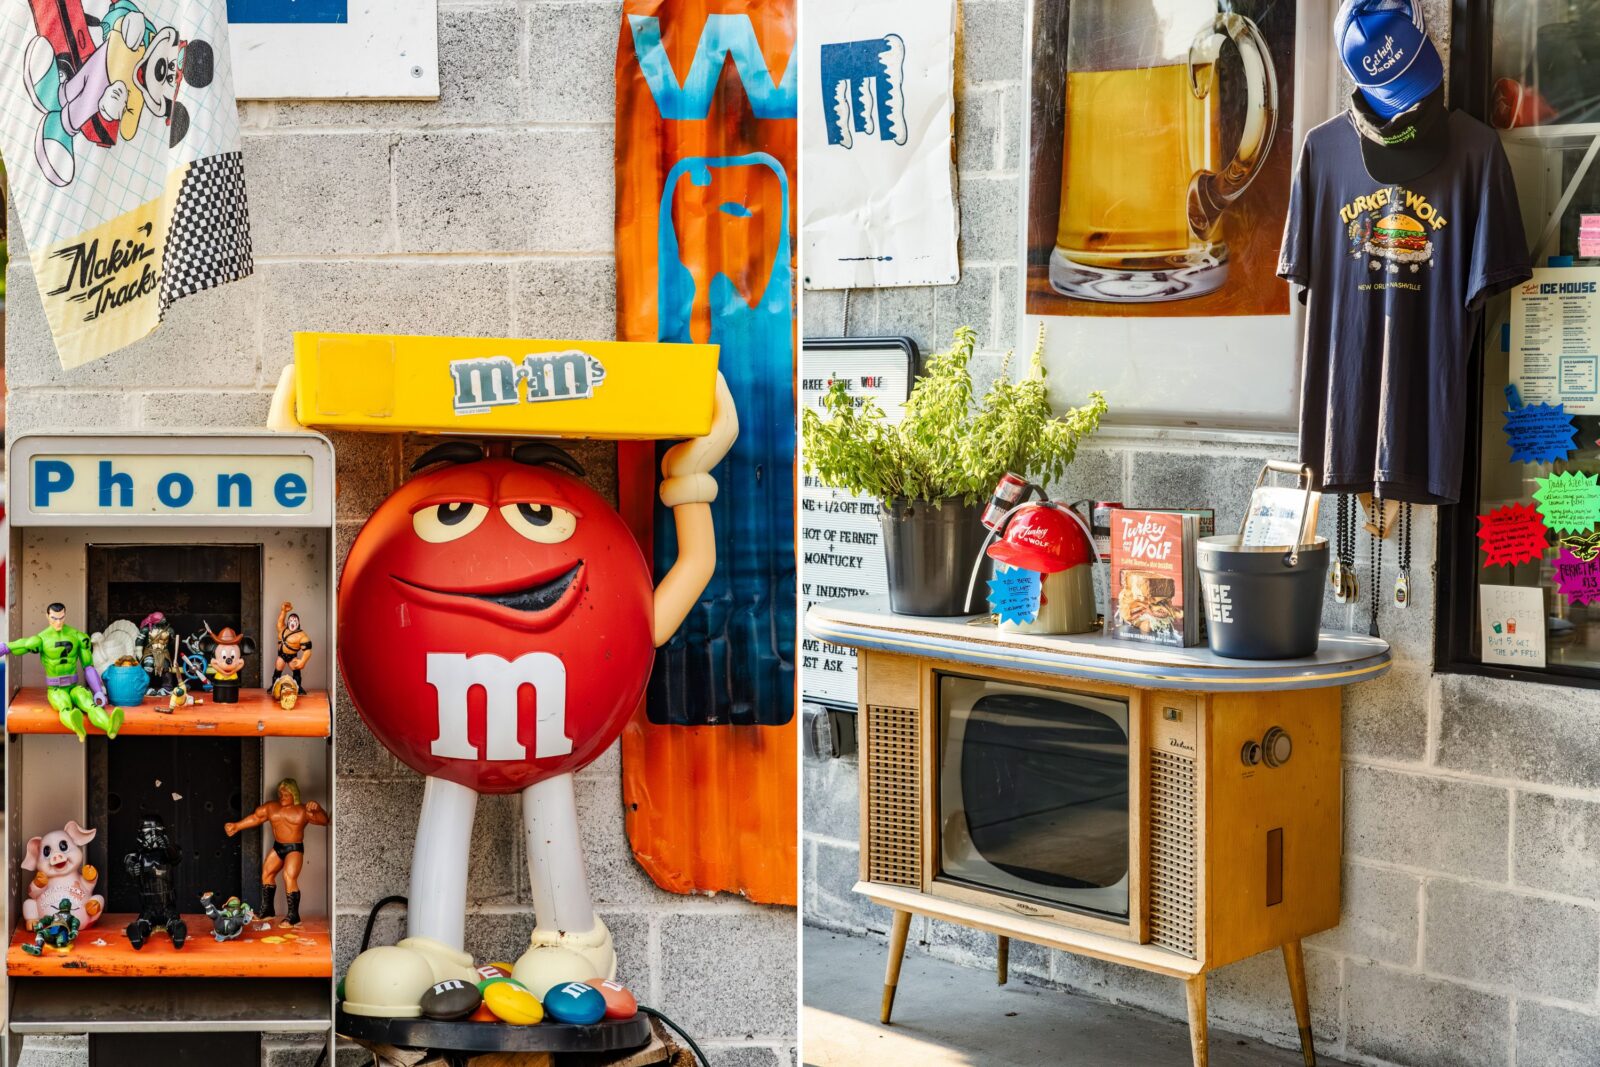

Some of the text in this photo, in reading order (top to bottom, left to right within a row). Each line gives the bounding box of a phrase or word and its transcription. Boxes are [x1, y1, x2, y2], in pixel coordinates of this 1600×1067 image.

[1340, 187, 1447, 231] TURKEY WOLF
[50, 222, 155, 295] Makin'
[68, 262, 161, 321] Tracks
[1390, 282, 1421, 290] NASHVILLE
[1540, 283, 1557, 294] ICE
[1559, 282, 1596, 294] HOUSE
[861, 376, 882, 388] WOLF
[34, 460, 307, 508] Phone
[1018, 525, 1048, 540] Turkey
[1122, 515, 1166, 541] Turkey
[824, 529, 836, 541] OF
[840, 531, 878, 545] FERNET
[1029, 538, 1050, 547] WOLF
[1131, 536, 1172, 560] WOLF
[804, 553, 863, 568] MONTUCKY
[824, 660, 843, 672] ASK
[426, 652, 573, 760] m
[433, 979, 465, 996] m
[560, 981, 593, 999] m
